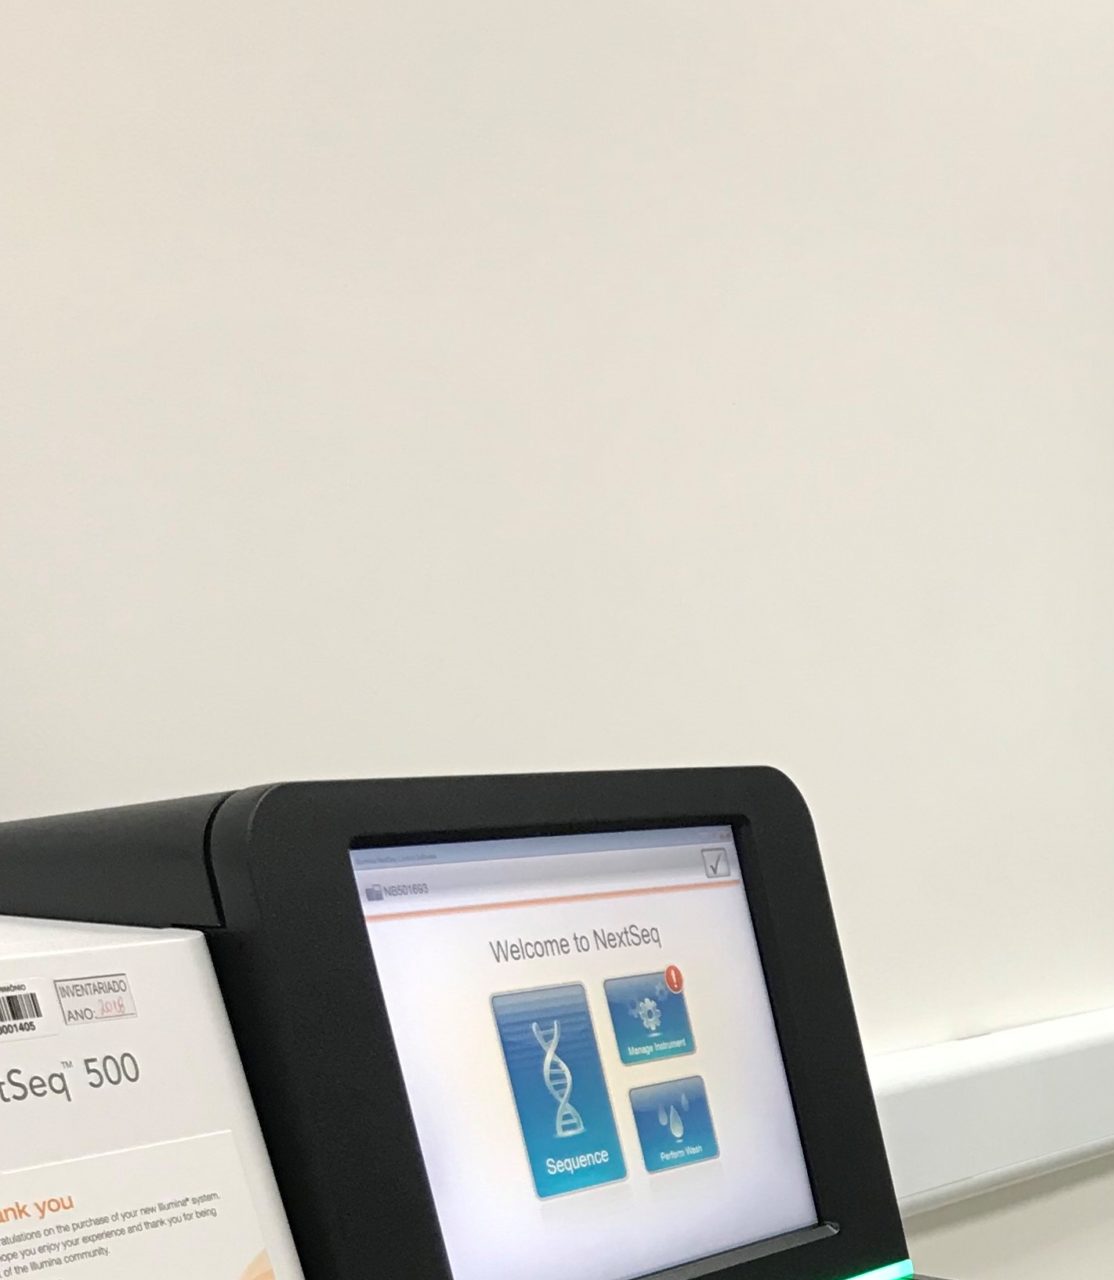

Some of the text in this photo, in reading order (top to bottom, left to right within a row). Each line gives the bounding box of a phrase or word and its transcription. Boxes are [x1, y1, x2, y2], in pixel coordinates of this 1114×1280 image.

[490, 924, 662, 963] Welcome to NextSeq
[58, 979, 127, 998] INVENTARIADO
[67, 1007, 96, 1022] ANO:
[627, 1038, 687, 1056] Manage Instrument
[84, 1052, 140, 1089] 500
[546, 1149, 609, 1175] Sequence
[660, 1144, 703, 1162] Perform Wash
[34, 1195, 74, 1220] you
[0, 1231, 41, 1247] atulations
[43, 1227, 55, 1238] on
[56, 1223, 70, 1234] the
[72, 1215, 110, 1232] purchase
[111, 1211, 120, 1222] of
[120, 1209, 138, 1222] your
[140, 1205, 157, 1216] new
[0, 1207, 218, 1263] ope you enjoy your experience and thank you for being
[3, 1266, 12, 1278] of
[14, 1264, 29, 1275] the
[30, 1256, 62, 1272] Illumina
[63, 1246, 110, 1264] community.
